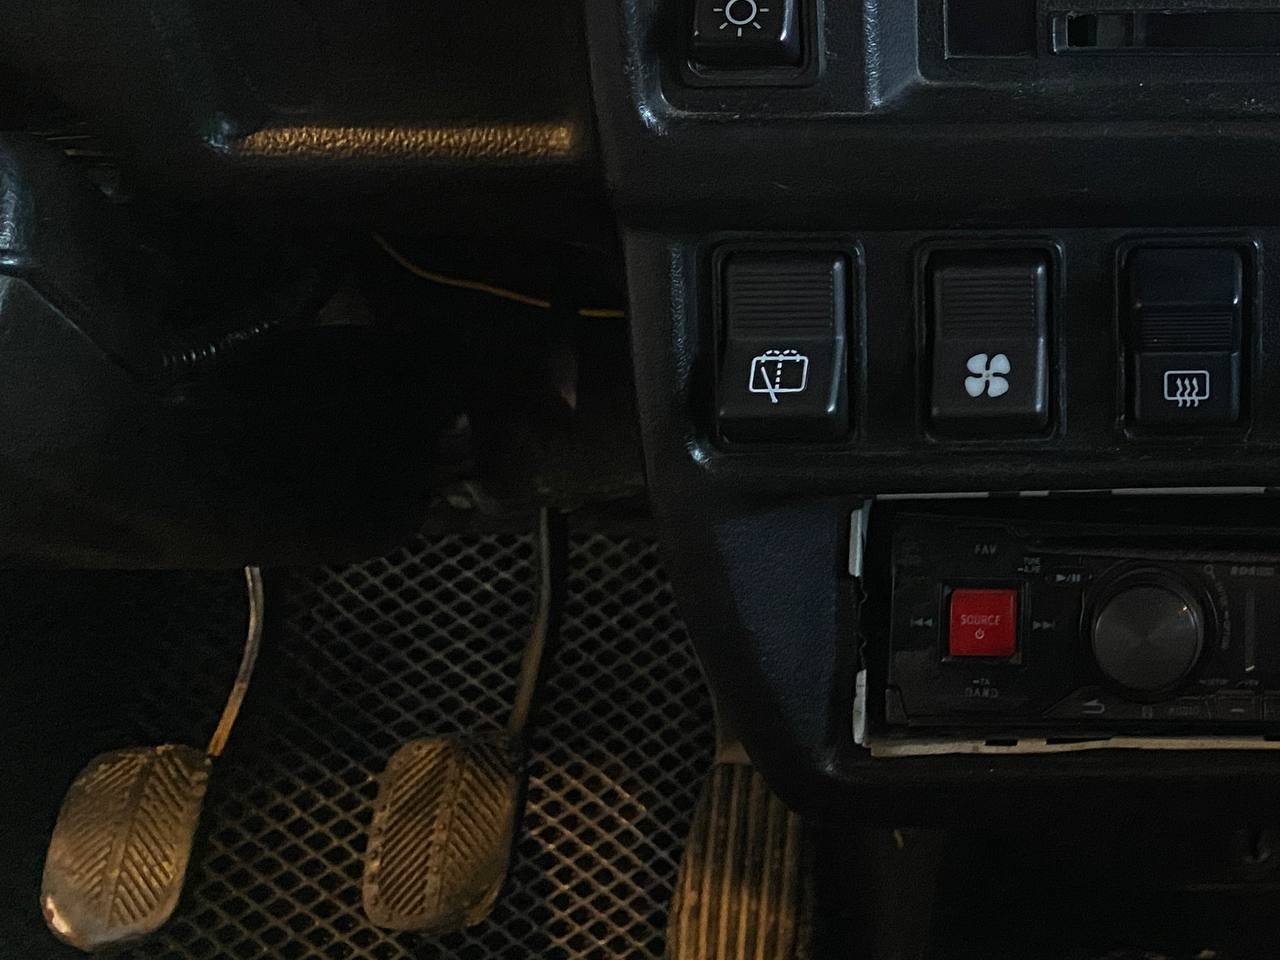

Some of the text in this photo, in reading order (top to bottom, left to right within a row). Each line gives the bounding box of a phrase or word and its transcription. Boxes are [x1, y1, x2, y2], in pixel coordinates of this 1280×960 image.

[971, 543, 998, 555] FAV
[960, 614, 1001, 626] SOURCE
[964, 686, 999, 699] BAND
